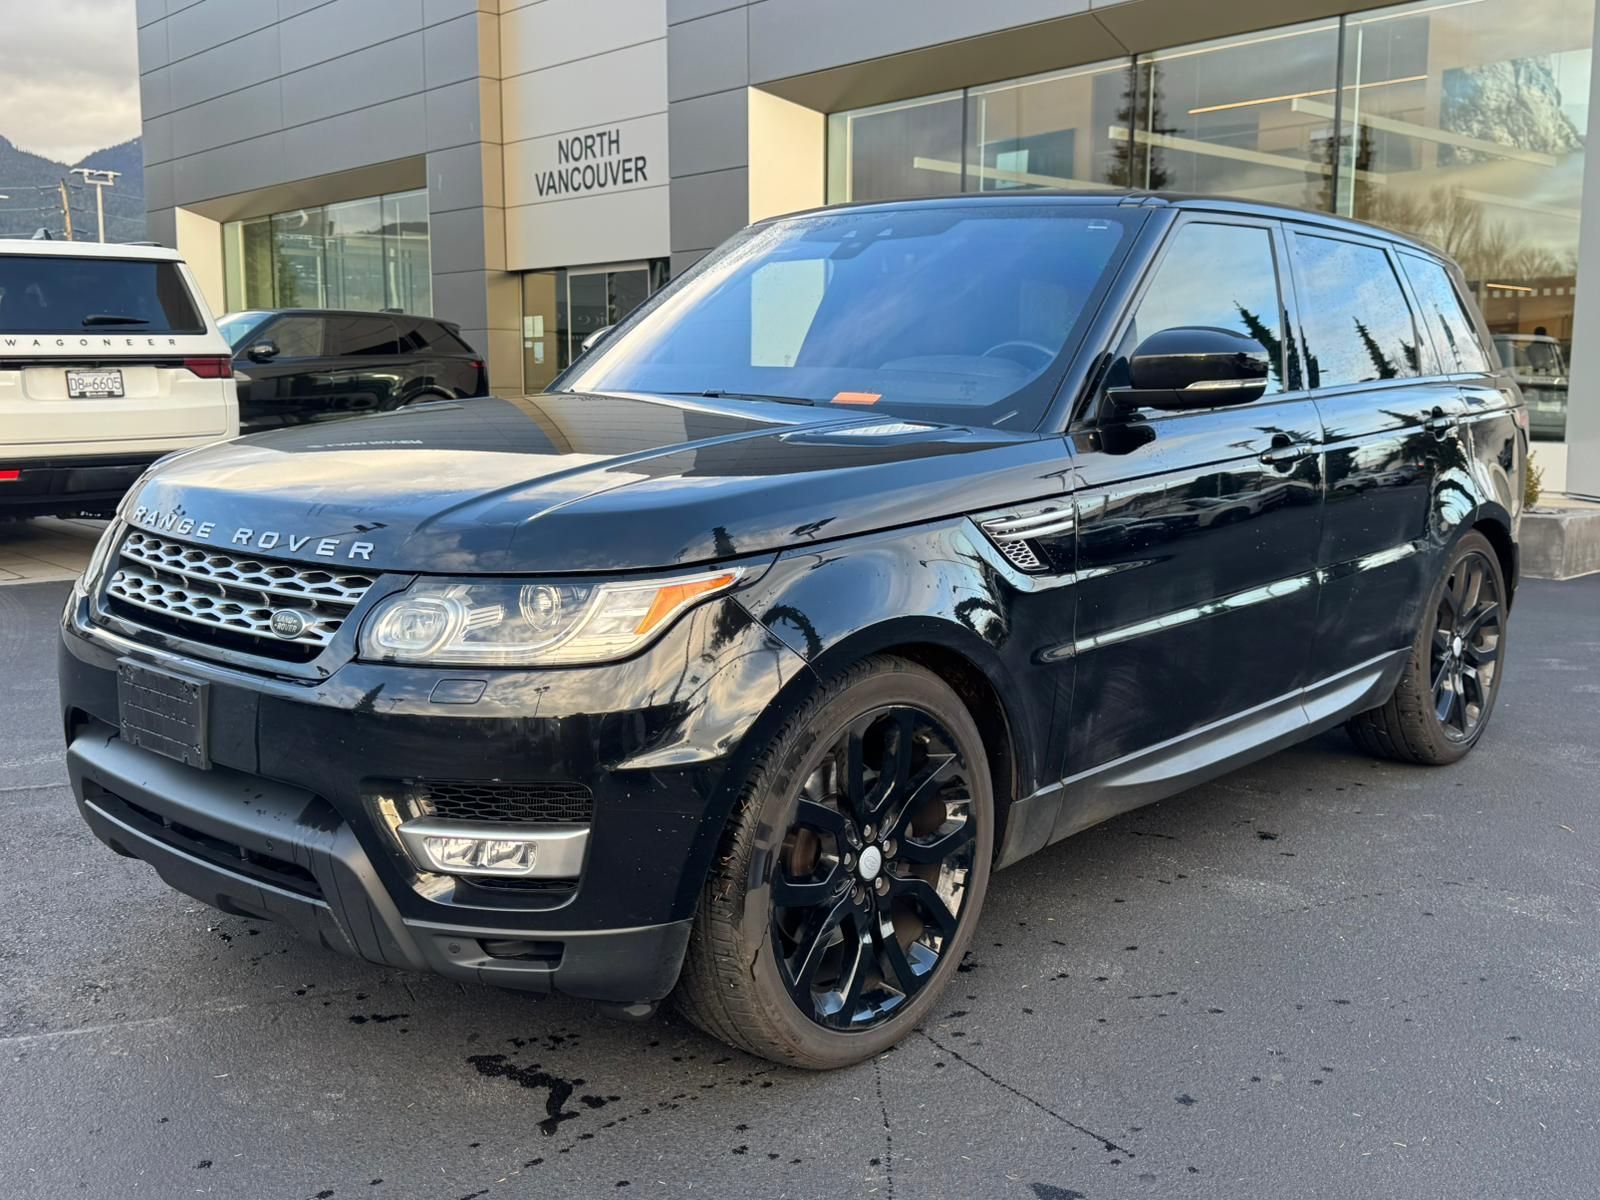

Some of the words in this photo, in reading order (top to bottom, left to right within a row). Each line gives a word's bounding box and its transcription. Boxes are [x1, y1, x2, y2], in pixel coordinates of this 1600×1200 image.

[558, 128, 620, 164] NORTH
[535, 156, 648, 197] VANCOUVER
[5, 338, 176, 347] WAGONEER
[133, 505, 216, 539] RANGE
[231, 527, 376, 561] ROVER
[276, 614, 294, 624] LAND
[276, 622, 298, 633] ROVER
